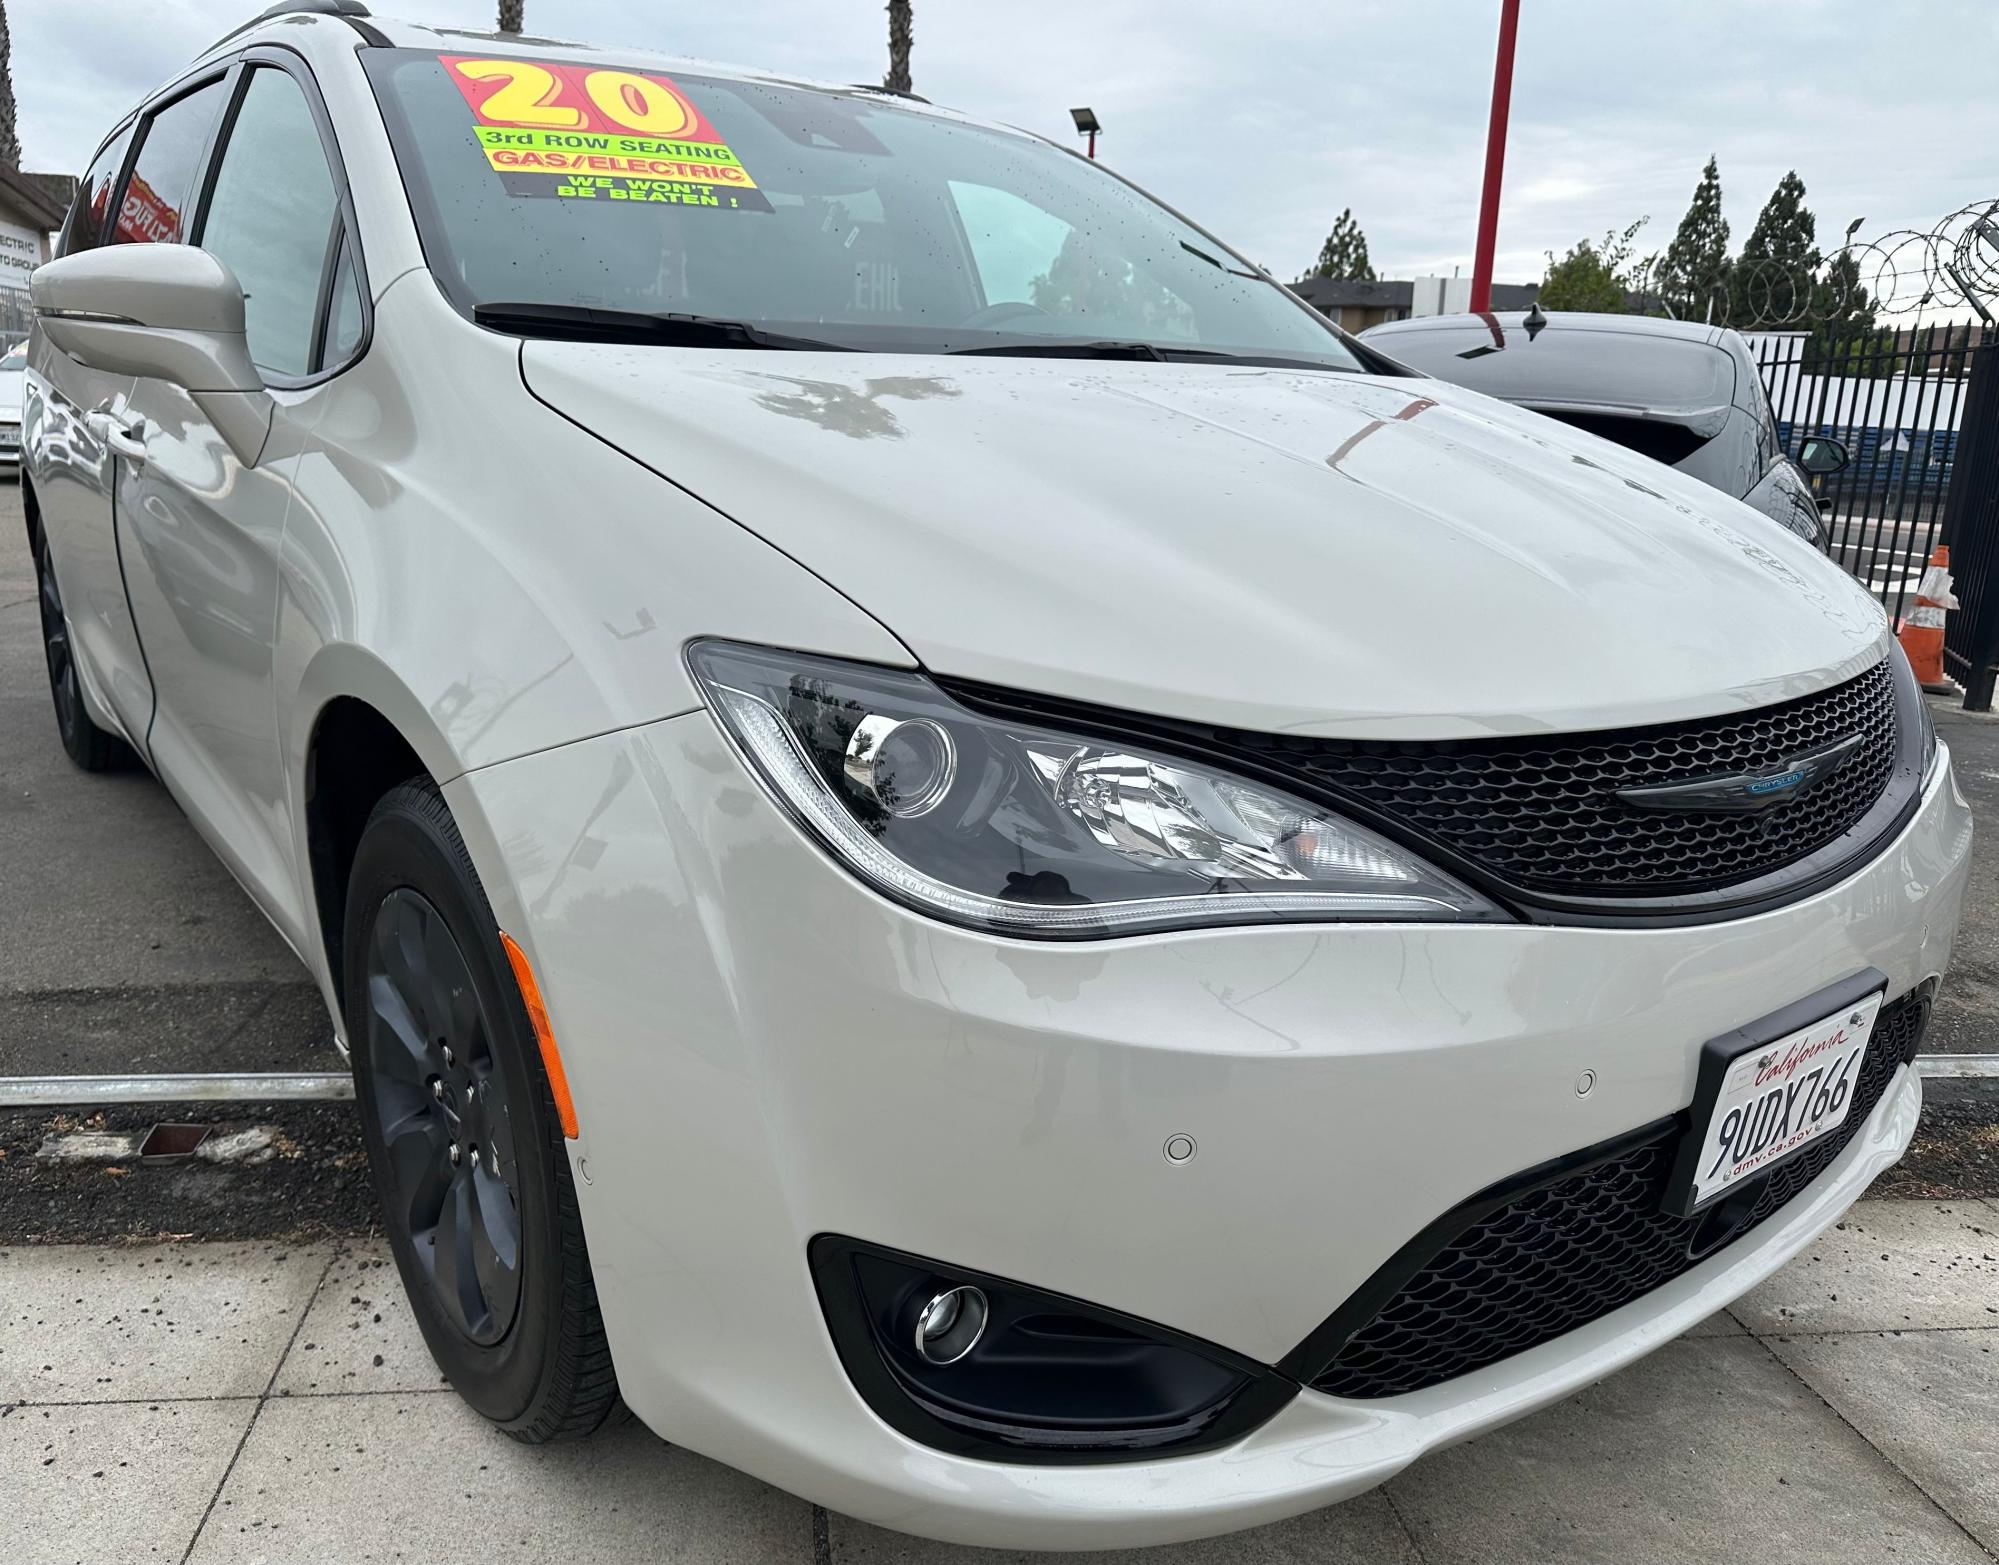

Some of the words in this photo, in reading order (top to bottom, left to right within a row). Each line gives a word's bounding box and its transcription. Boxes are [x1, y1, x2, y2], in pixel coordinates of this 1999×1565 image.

[455, 60, 698, 138] 20
[485, 131, 534, 146] 3rd
[544, 133, 609, 150] ROW
[619, 139, 731, 161] SEATING
[492, 150, 745, 182] GAS/ELECTRIC
[557, 186, 597, 198] BE
[609, 188, 719, 207] BEATEN
[567, 175, 614, 189] WE
[625, 180, 714, 195] WON'T
[1751, 774, 1799, 791] CHRYSLER
[1754, 1024, 1849, 1087] California
[1707, 1047, 1860, 1180] 9UDX766
[1732, 1126, 1813, 1176] dmv.ca.gov
